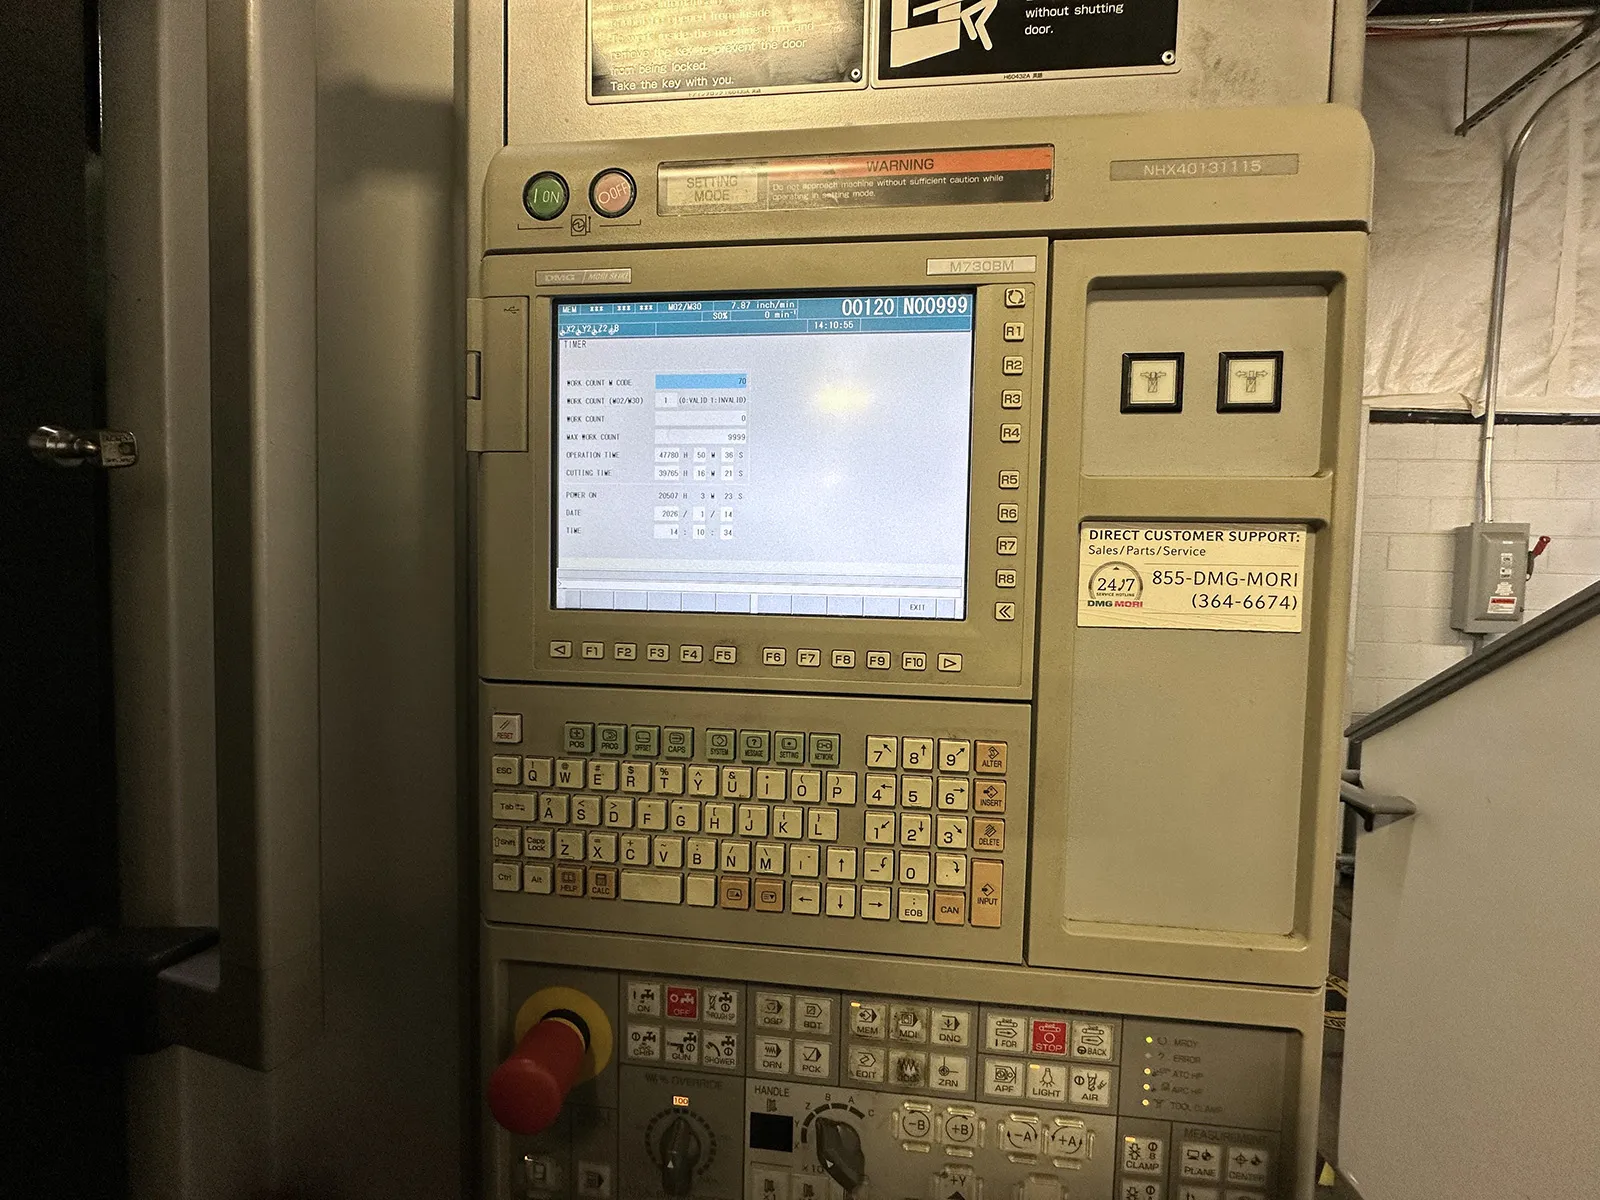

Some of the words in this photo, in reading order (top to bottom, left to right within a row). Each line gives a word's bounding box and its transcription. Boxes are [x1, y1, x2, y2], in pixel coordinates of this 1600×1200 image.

[1025, 5, 1069, 18] without
[1074, 2, 1124, 15] shutting
[1024, 24, 1054, 35] door.
[761, 40, 778, 50] the
[783, 39, 807, 49] door
[639, 62, 667, 74] being
[671, 61, 708, 72] locked.
[610, 81, 636, 91] Take
[641, 79, 658, 89] the
[661, 79, 681, 89] key
[686, 76, 708, 87] with
[712, 76, 734, 86] you.
[867, 158, 934, 172] WARNING
[1143, 159, 1262, 176] NHX40131115
[687, 175, 738, 189] SETTING
[841, 180, 874, 188] machine
[877, 179, 906, 187] without
[910, 177, 947, 186] sufficient
[950, 175, 979, 184] caution
[609, 182, 629, 198] OFF
[542, 190, 560, 203] ON
[694, 190, 730, 202] MODE
[950, 260, 1015, 272] M730BM
[731, 301, 751, 309] 7.87
[756, 300, 795, 309] inch/min
[903, 296, 968, 315] N00999
[814, 320, 854, 330] 14:10:55
[1006, 326, 1022, 336] R1
[564, 340, 587, 349] TIMER
[1005, 360, 1022, 370] R2
[566, 379, 582, 387] WORK
[585, 379, 605, 387] COUNT
[616, 378, 633, 386] CODE
[738, 377, 747, 385] 70
[566, 397, 582, 405] WORK
[585, 397, 605, 405] COUNT
[1004, 394, 1021, 404] R3
[727, 433, 746, 441] 9999
[1003, 428, 1020, 438] R4
[565, 469, 594, 477] CUTTING
[597, 469, 612, 477] TIME
[1001, 475, 1018, 485] R5
[565, 491, 586, 499] POWER
[588, 491, 597, 499] ON
[658, 492, 679, 500] 20507
[565, 509, 581, 517] DATE
[724, 510, 733, 518] 14
[1000, 508, 1017, 518] R6
[566, 527, 581, 535] TIME
[670, 528, 678, 536] 14
[696, 528, 705, 536] 10
[1089, 530, 1140, 541] DIRECT
[1144, 530, 1224, 542] CUSTOMER
[1228, 531, 1300, 543] SUPPORT:
[999, 540, 1016, 550] R7
[1088, 545, 1206, 557] Sales/Parts/Service
[998, 574, 1015, 584] R8
[1152, 570, 1298, 588] 855-DMG-MORI
[1114, 600, 1143, 608] MORI
[1191, 593, 1298, 611] (364-6674)
[586, 646, 598, 656] F1
[617, 648, 632, 657] F2
[650, 648, 665, 658] F3
[682, 650, 698, 659] F4
[716, 650, 731, 660] F5
[766, 652, 781, 662] F6
[800, 653, 815, 663] F7
[835, 655, 851, 665] F8
[869, 656, 885, 666] F9
[905, 657, 924, 668] F10
[496, 732, 514, 740] RESET
[569, 740, 585, 749] POS
[601, 742, 619, 750] PROG
[668, 746, 686, 754] CAPS
[710, 748, 729, 756] SYSTEM
[744, 750, 763, 758] MESSAGE
[779, 751, 799, 759] SETTING
[814, 753, 834, 761] NETWORK
[982, 759, 1002, 768] ALTER
[496, 767, 512, 775] ESC
[500, 803, 514, 811] Tab
[980, 799, 1002, 807] INSERT
[500, 838, 516, 847] Shift
[526, 837, 545, 845] Caps
[978, 838, 1000, 846] DELETE
[560, 884, 578, 892] HELP
[592, 887, 610, 895] CALC
[977, 897, 998, 906] INPUT
[904, 909, 923, 917] EOB
[940, 906, 960, 914] CAN
[857, 1026, 879, 1035] MEM
[939, 1033, 961, 1043] DNC
[1001, 1040, 1017, 1048] FOR
[1035, 1043, 1063, 1052] STOP
[671, 1052, 691, 1061] GUN
[1087, 1048, 1107, 1057] BACK
[704, 1056, 735, 1066] SHOWER
[856, 1070, 877, 1079] EDIT
[938, 1079, 959, 1087] ZRN
[754, 1085, 790, 1097] HANDLE
[994, 1085, 1014, 1093] APF
[1032, 1087, 1061, 1098] LIGHT
[674, 1097, 689, 1105] 100
[1081, 1093, 1099, 1101] AIR
[1125, 1160, 1160, 1171] CLAMP
